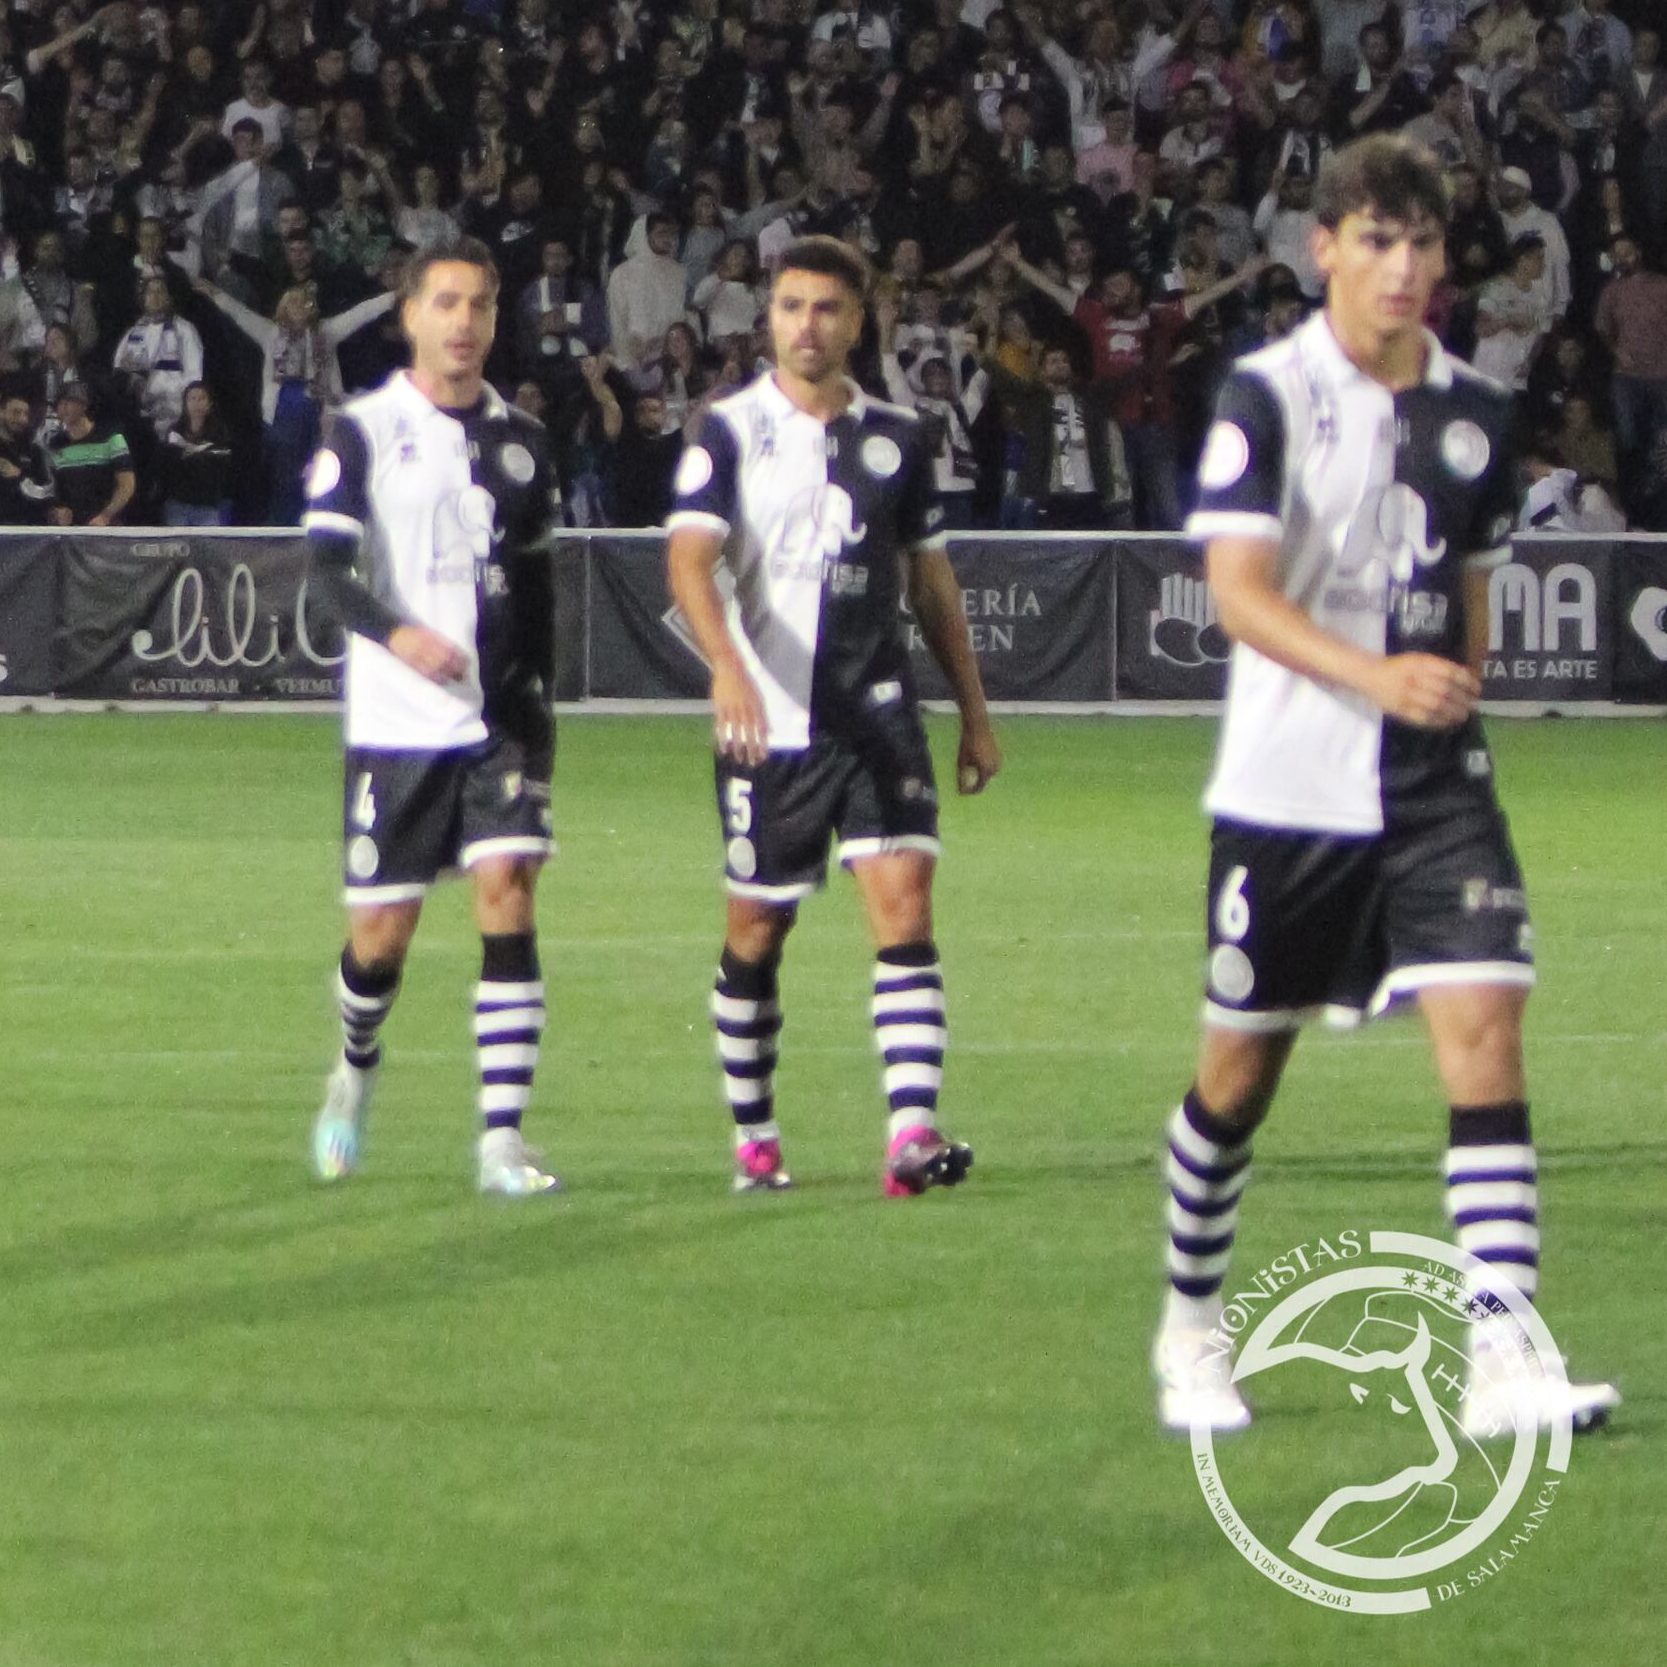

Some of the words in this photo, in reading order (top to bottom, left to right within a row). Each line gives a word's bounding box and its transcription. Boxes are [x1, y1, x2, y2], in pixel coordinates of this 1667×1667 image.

[130, 678, 240, 695] GASTROBAR
[1512, 659, 1538, 679] ES
[1541, 659, 1599, 680] ARTE
[726, 776, 753, 836] 5
[1219, 864, 1250, 943] 6
